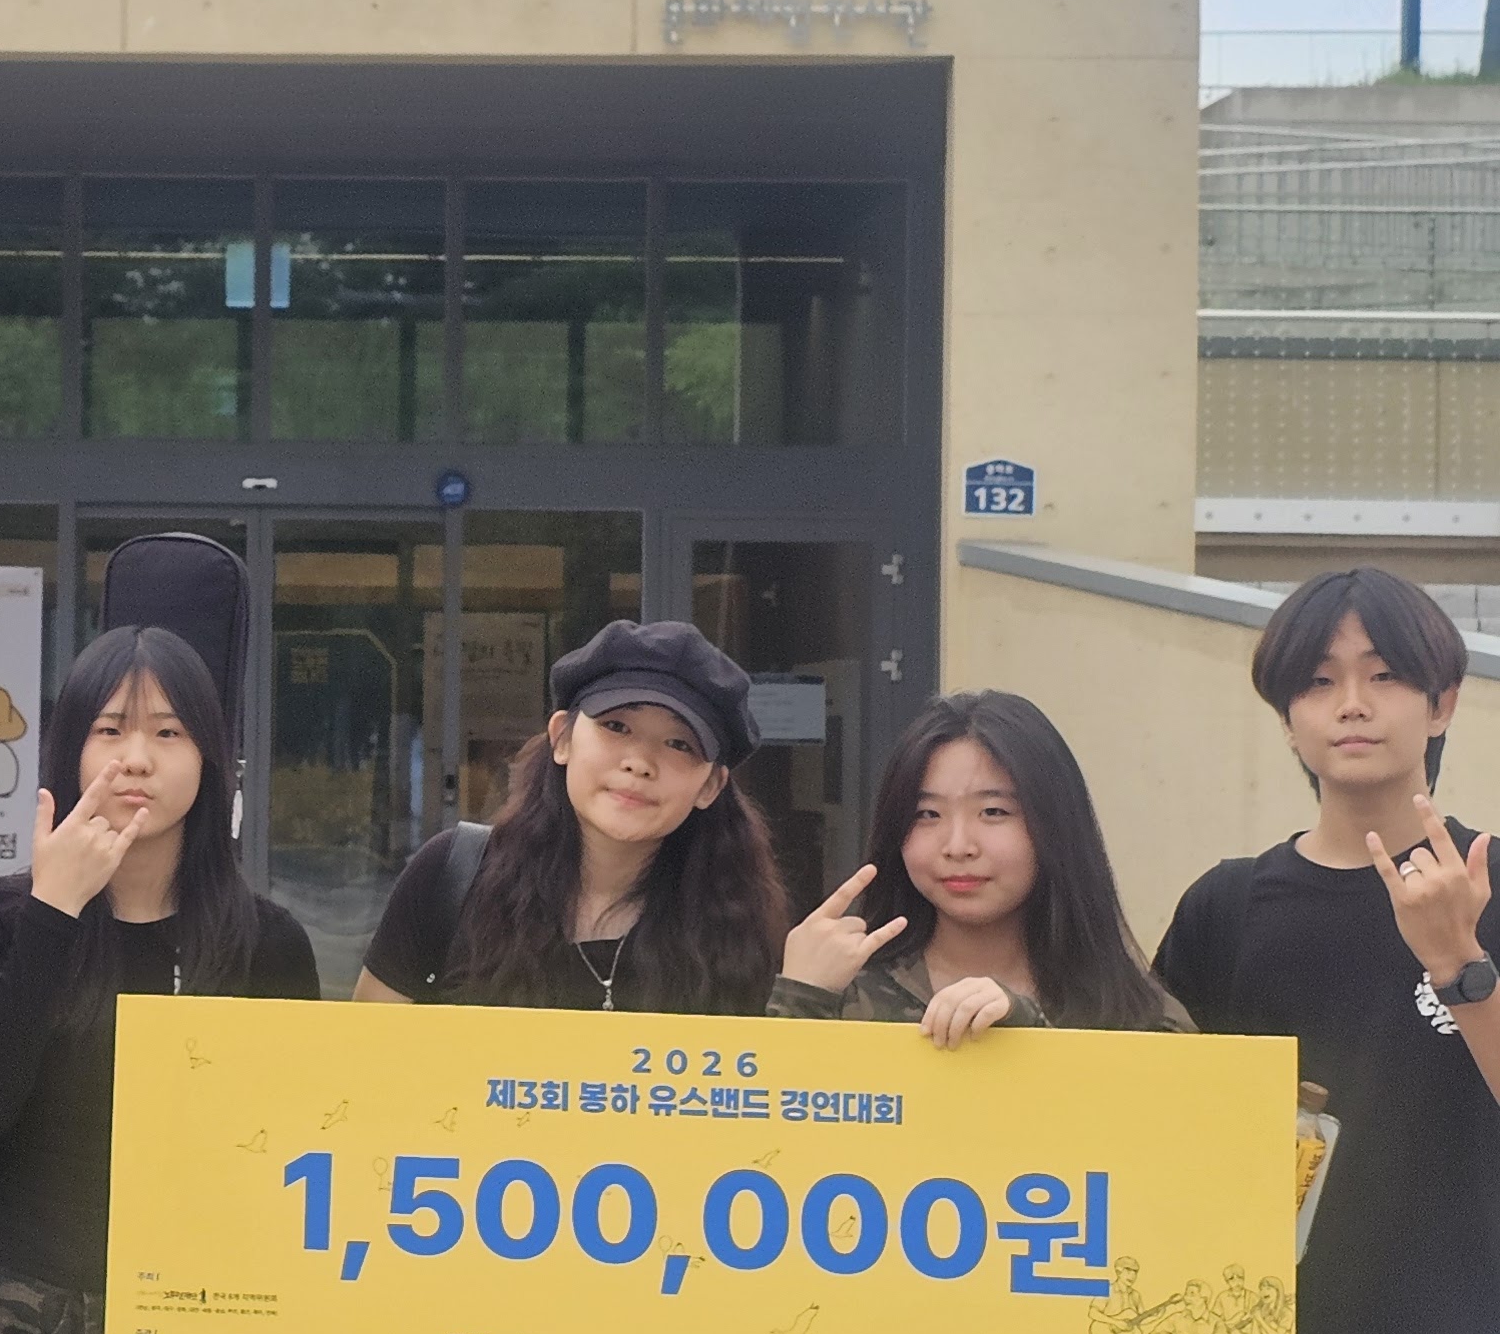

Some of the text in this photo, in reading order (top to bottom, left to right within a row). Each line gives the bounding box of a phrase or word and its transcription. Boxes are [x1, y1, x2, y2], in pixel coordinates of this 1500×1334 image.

[974, 486, 1026, 512] 132
[486, 1078, 904, 1126] 제3회 봉하 유스밴드 경연대회
[282, 1149, 1111, 1299] 1,500,000원
